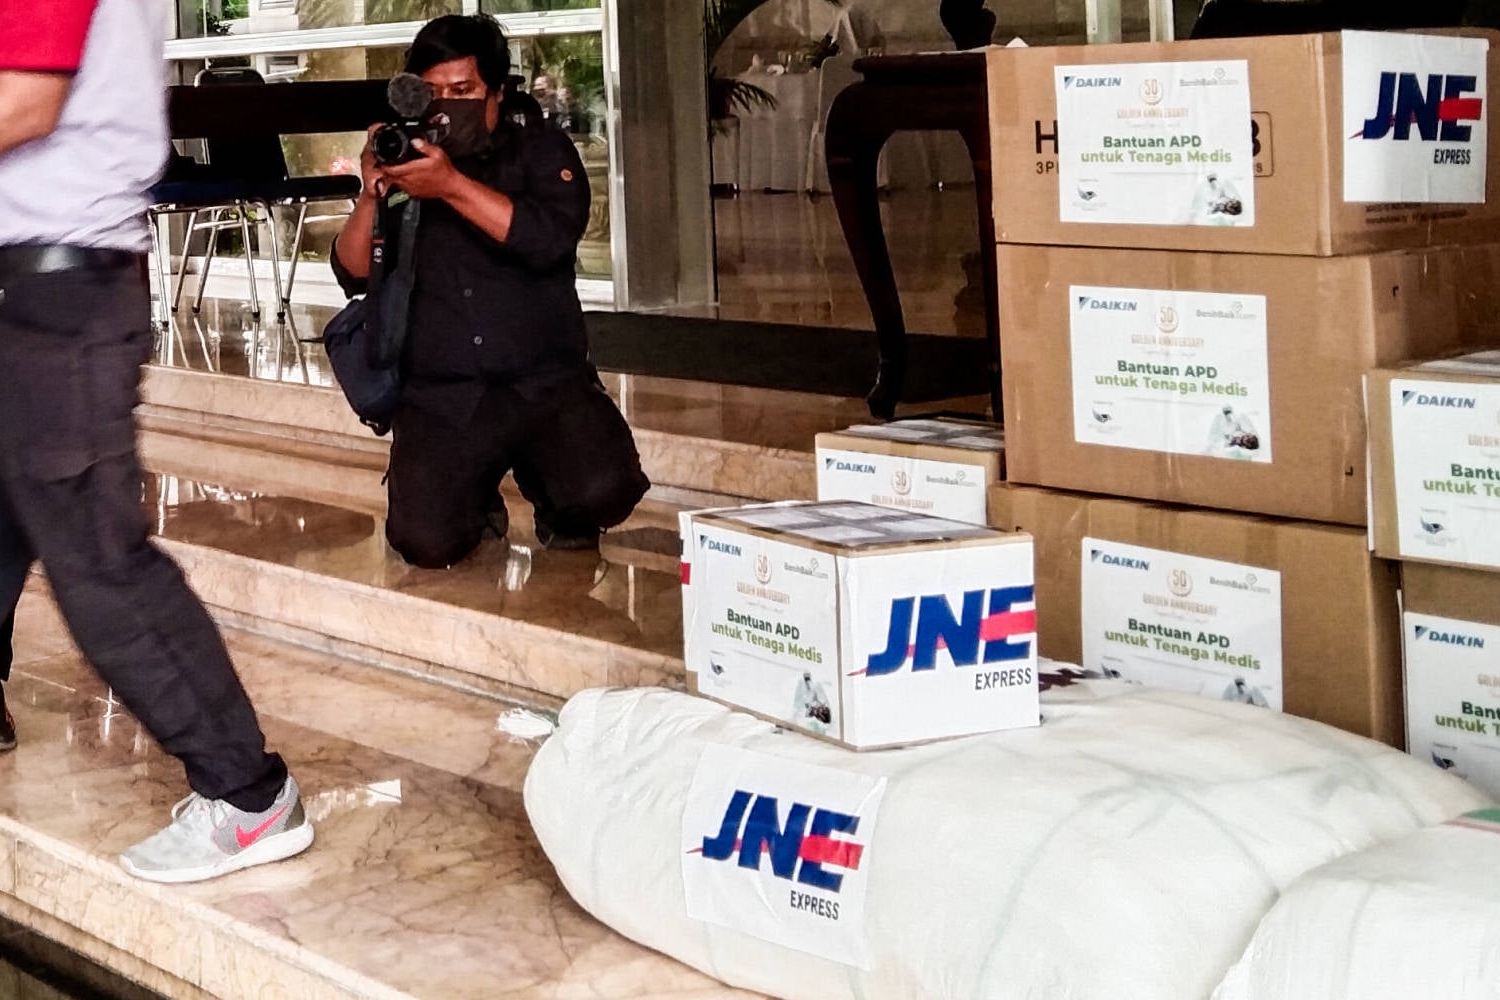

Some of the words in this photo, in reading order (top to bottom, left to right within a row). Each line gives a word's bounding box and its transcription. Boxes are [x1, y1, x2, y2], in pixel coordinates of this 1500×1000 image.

[1075, 77, 1122, 88] DAIKIN
[1143, 78, 1159, 96] 50
[1361, 72, 1483, 142] JNE
[1103, 136, 1165, 148] Bantuan
[1169, 135, 1202, 147] APD
[1081, 151, 1124, 163] untuk
[1128, 150, 1182, 165] Tenaga
[1187, 150, 1232, 163] Medis
[1433, 149, 1472, 165] EXPRESS
[1090, 299, 1138, 312] DAIKIN
[1159, 306, 1175, 324] 50
[1117, 360, 1180, 376] Bantuan
[1184, 365, 1218, 379] APD
[1095, 374, 1138, 388] untuk
[1143, 377, 1197, 394] Tenaga
[1202, 381, 1248, 397] Medis
[1417, 394, 1477, 409] DAIKIN
[836, 461, 877, 475] DAIKIN
[1423, 479, 1477, 496] untuk
[708, 540, 742, 557] DAIKIN
[1102, 554, 1151, 571] DAIKIN
[1172, 569, 1188, 588] 50
[726, 608, 772, 633] Bantuan
[775, 622, 800, 640] APD
[864, 585, 1037, 678] JNE
[1128, 618, 1192, 641] Bantuan
[1196, 631, 1231, 649] APD
[711, 621, 746, 641] untuk
[746, 630, 785, 654] Tenaga
[788, 643, 823, 664] Medis
[1104, 630, 1149, 648] untuk
[1153, 639, 1209, 661] Tenaga
[1214, 650, 1261, 671] Medis
[1428, 630, 1485, 649] DAIKIN
[974, 667, 1033, 691] EXPRESS
[1435, 714, 1487, 735] untuk
[700, 789, 865, 893] JNE
[790, 890, 840, 920] EXPRESS
